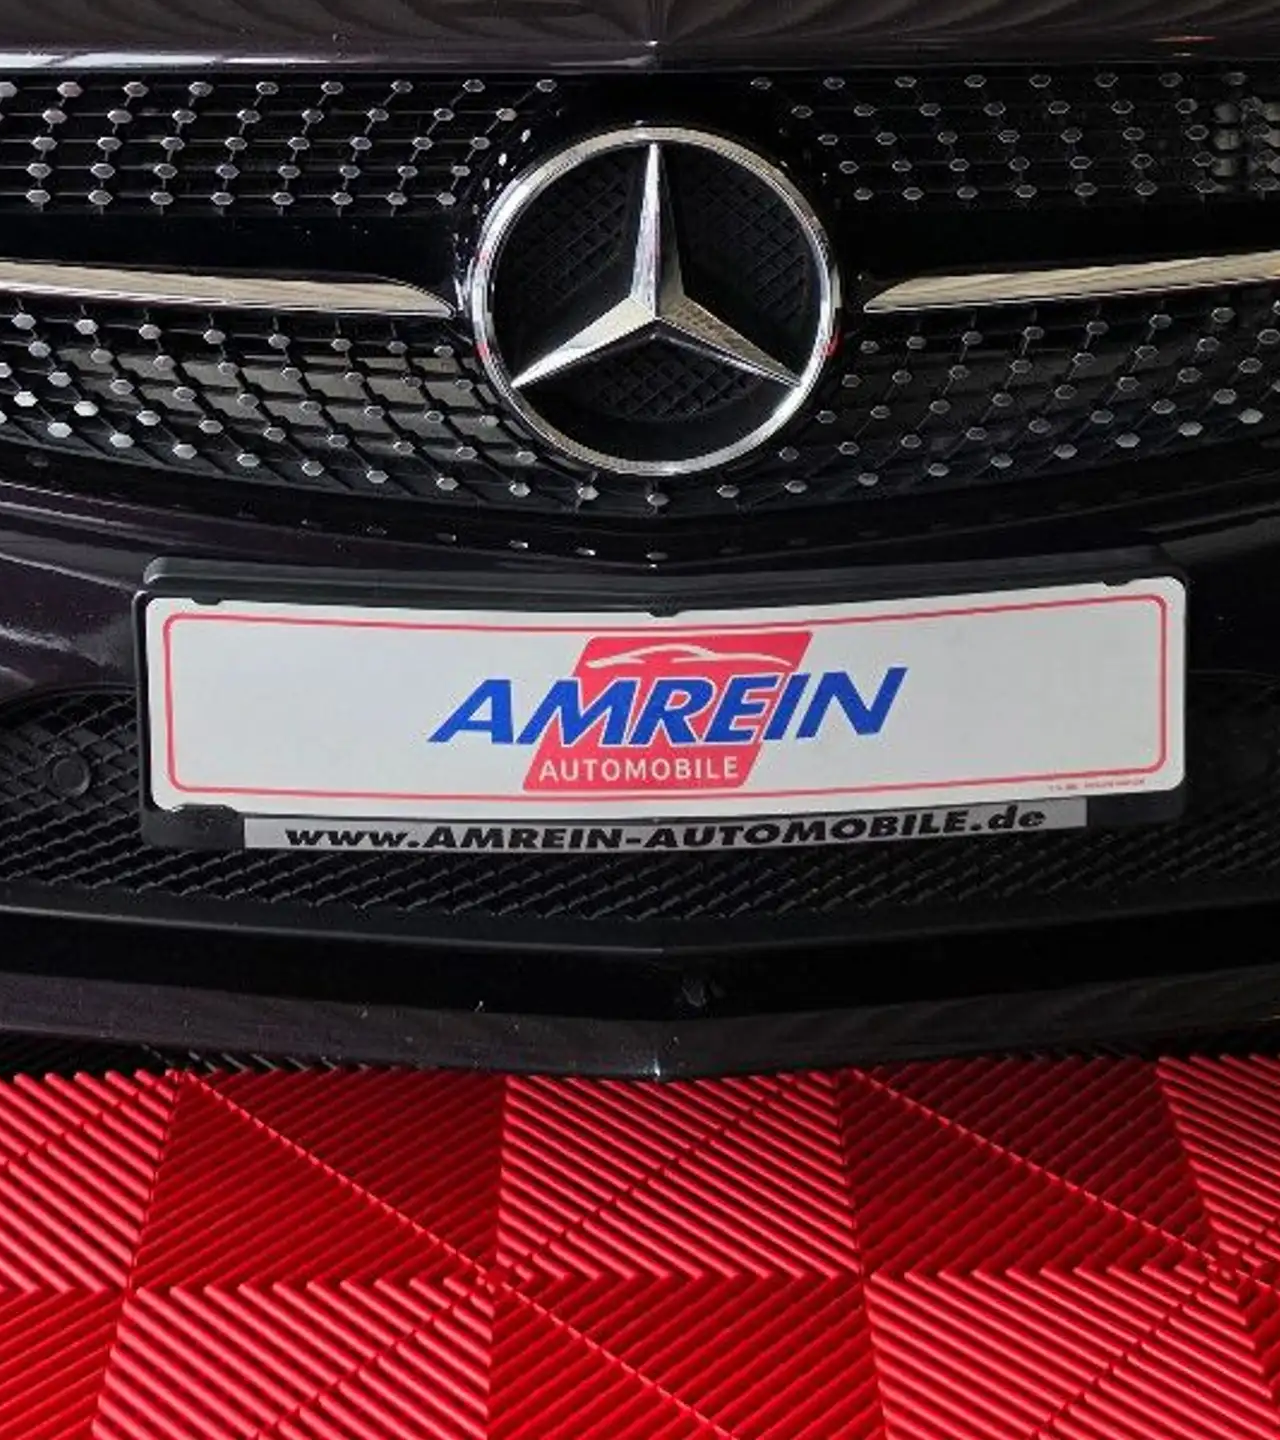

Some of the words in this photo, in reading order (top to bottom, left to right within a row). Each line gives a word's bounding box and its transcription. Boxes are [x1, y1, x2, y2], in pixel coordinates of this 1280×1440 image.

[426, 666, 910, 747] AMREIN
[537, 755, 740, 782] AUTOMOBILE
[283, 804, 1048, 851] www.AMREIN-AUTOMOBILE.de
